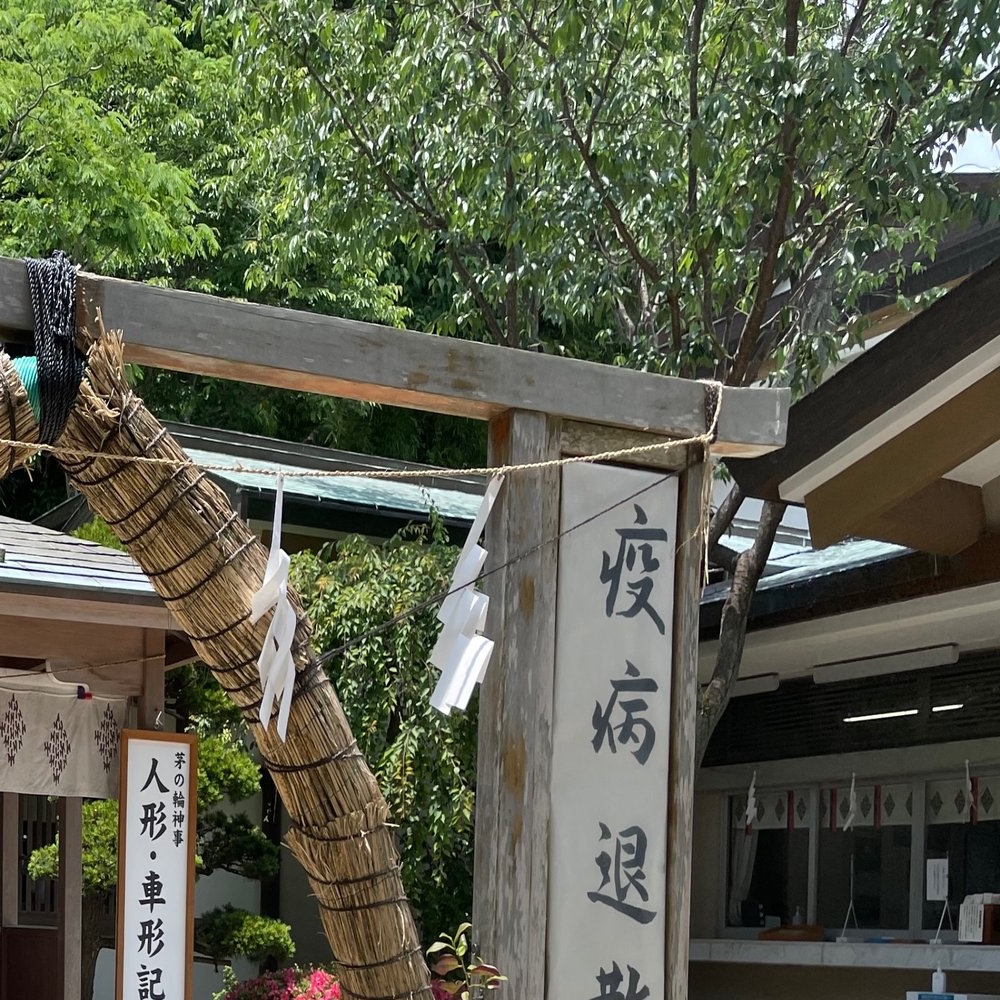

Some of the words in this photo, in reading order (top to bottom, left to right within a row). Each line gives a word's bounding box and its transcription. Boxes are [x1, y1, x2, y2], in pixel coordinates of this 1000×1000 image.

[171, 751, 187, 849] 茅の輪神事
